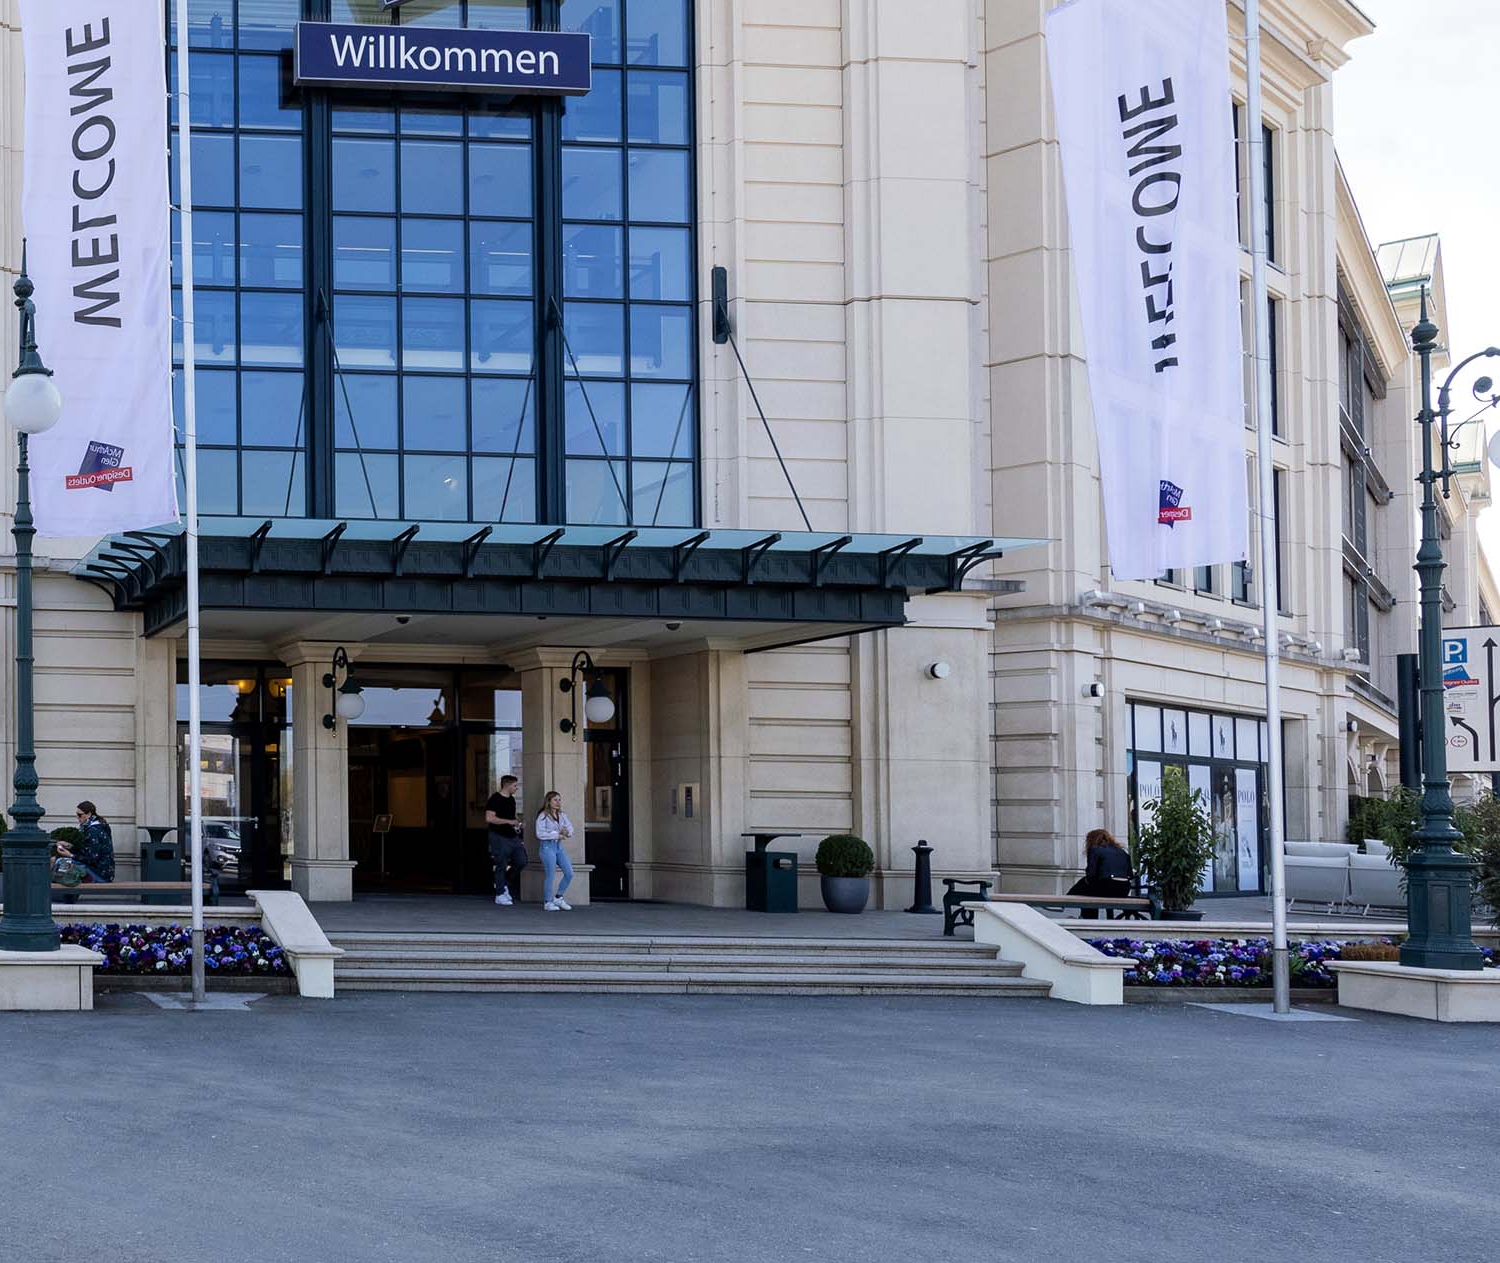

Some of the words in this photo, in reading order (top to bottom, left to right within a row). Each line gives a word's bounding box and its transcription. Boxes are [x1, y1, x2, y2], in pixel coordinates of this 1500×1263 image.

[330, 34, 559, 75] Willkommen
[1140, 784, 1160, 798] POLO
[1238, 790, 1255, 803] POLO
